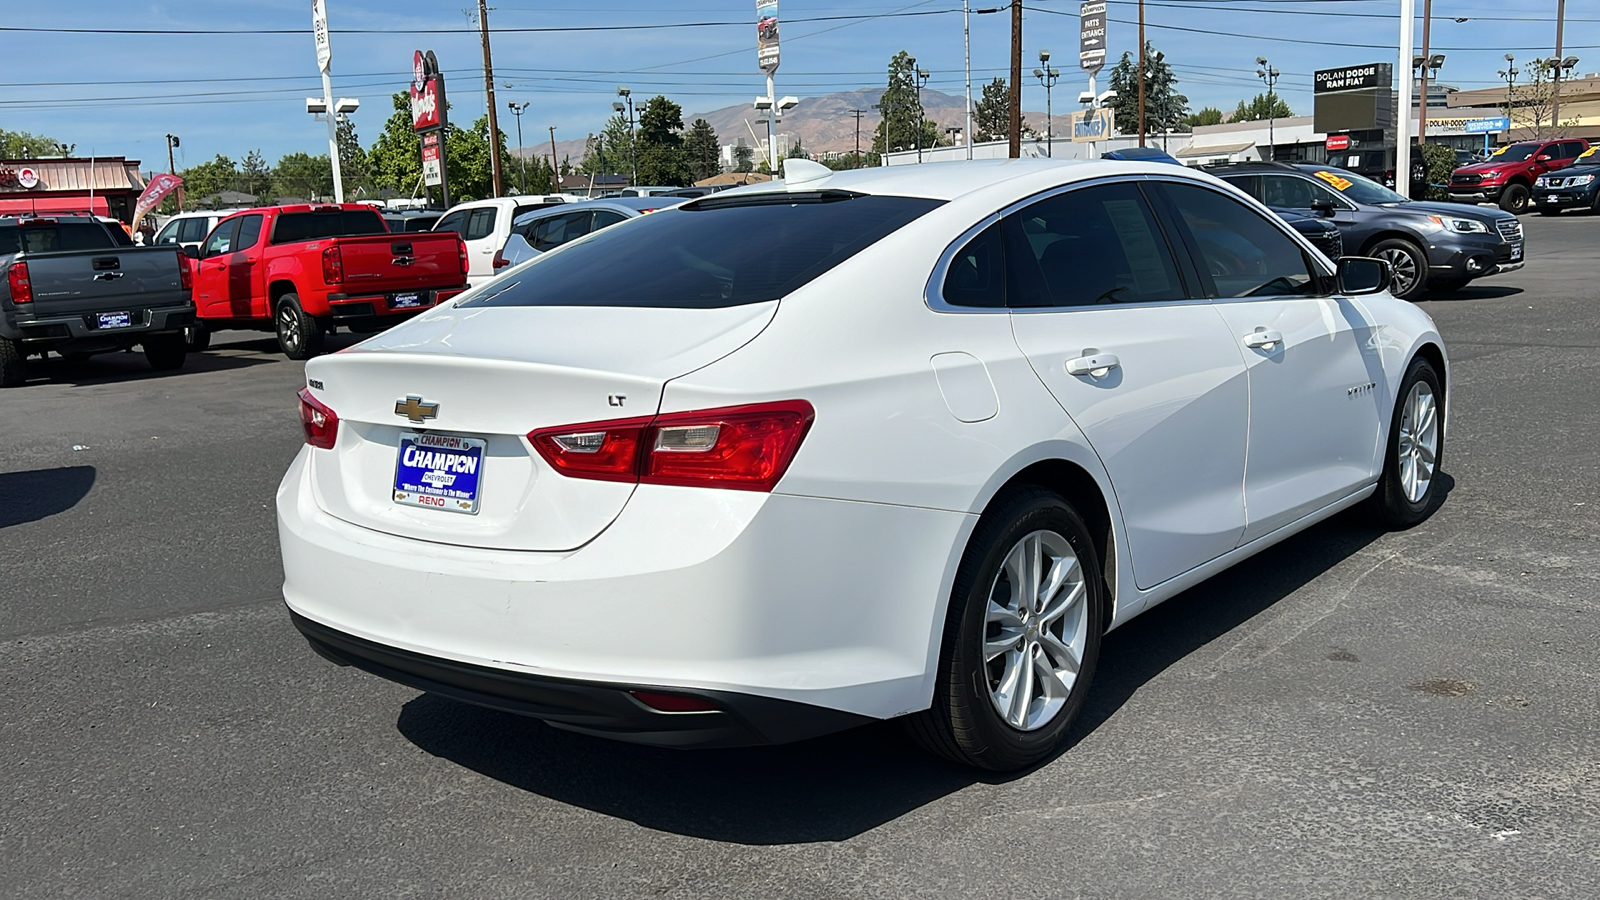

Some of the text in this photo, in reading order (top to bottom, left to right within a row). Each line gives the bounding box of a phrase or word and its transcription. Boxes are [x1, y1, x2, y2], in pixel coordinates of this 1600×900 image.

[1085, 18, 1100, 28] PARTS
[1081, 28, 1105, 39] ENTRANCE
[1316, 67, 1375, 82] DOLAN DODGE
[1326, 77, 1364, 89] RAM FIAT
[100, 314, 128, 322] CHAMPION
[608, 395, 626, 406] LT
[420, 435, 461, 448] CHAMPION
[402, 445, 478, 474] CHAMPION
[424, 473, 454, 483] CHEVROLET
[448, 489, 456, 497] The
[418, 495, 445, 507] RENO
